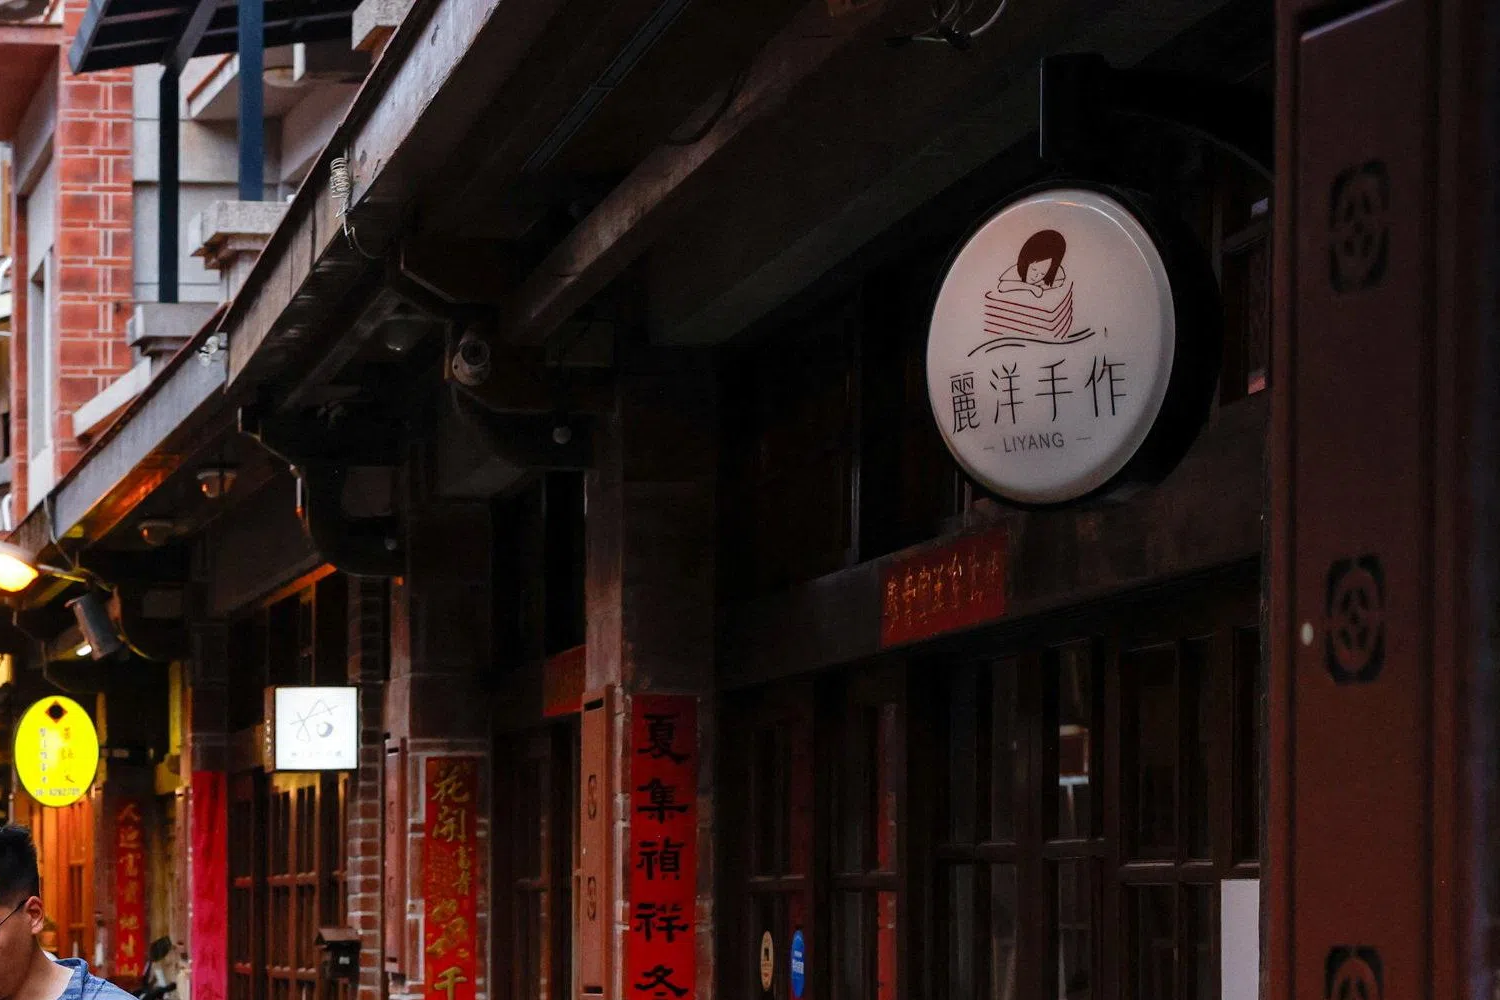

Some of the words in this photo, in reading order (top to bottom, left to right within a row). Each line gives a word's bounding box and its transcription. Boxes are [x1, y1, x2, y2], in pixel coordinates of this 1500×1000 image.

[950, 355, 1127, 434] 麗洋手作
[1003, 431, 1065, 454] LIYANG
